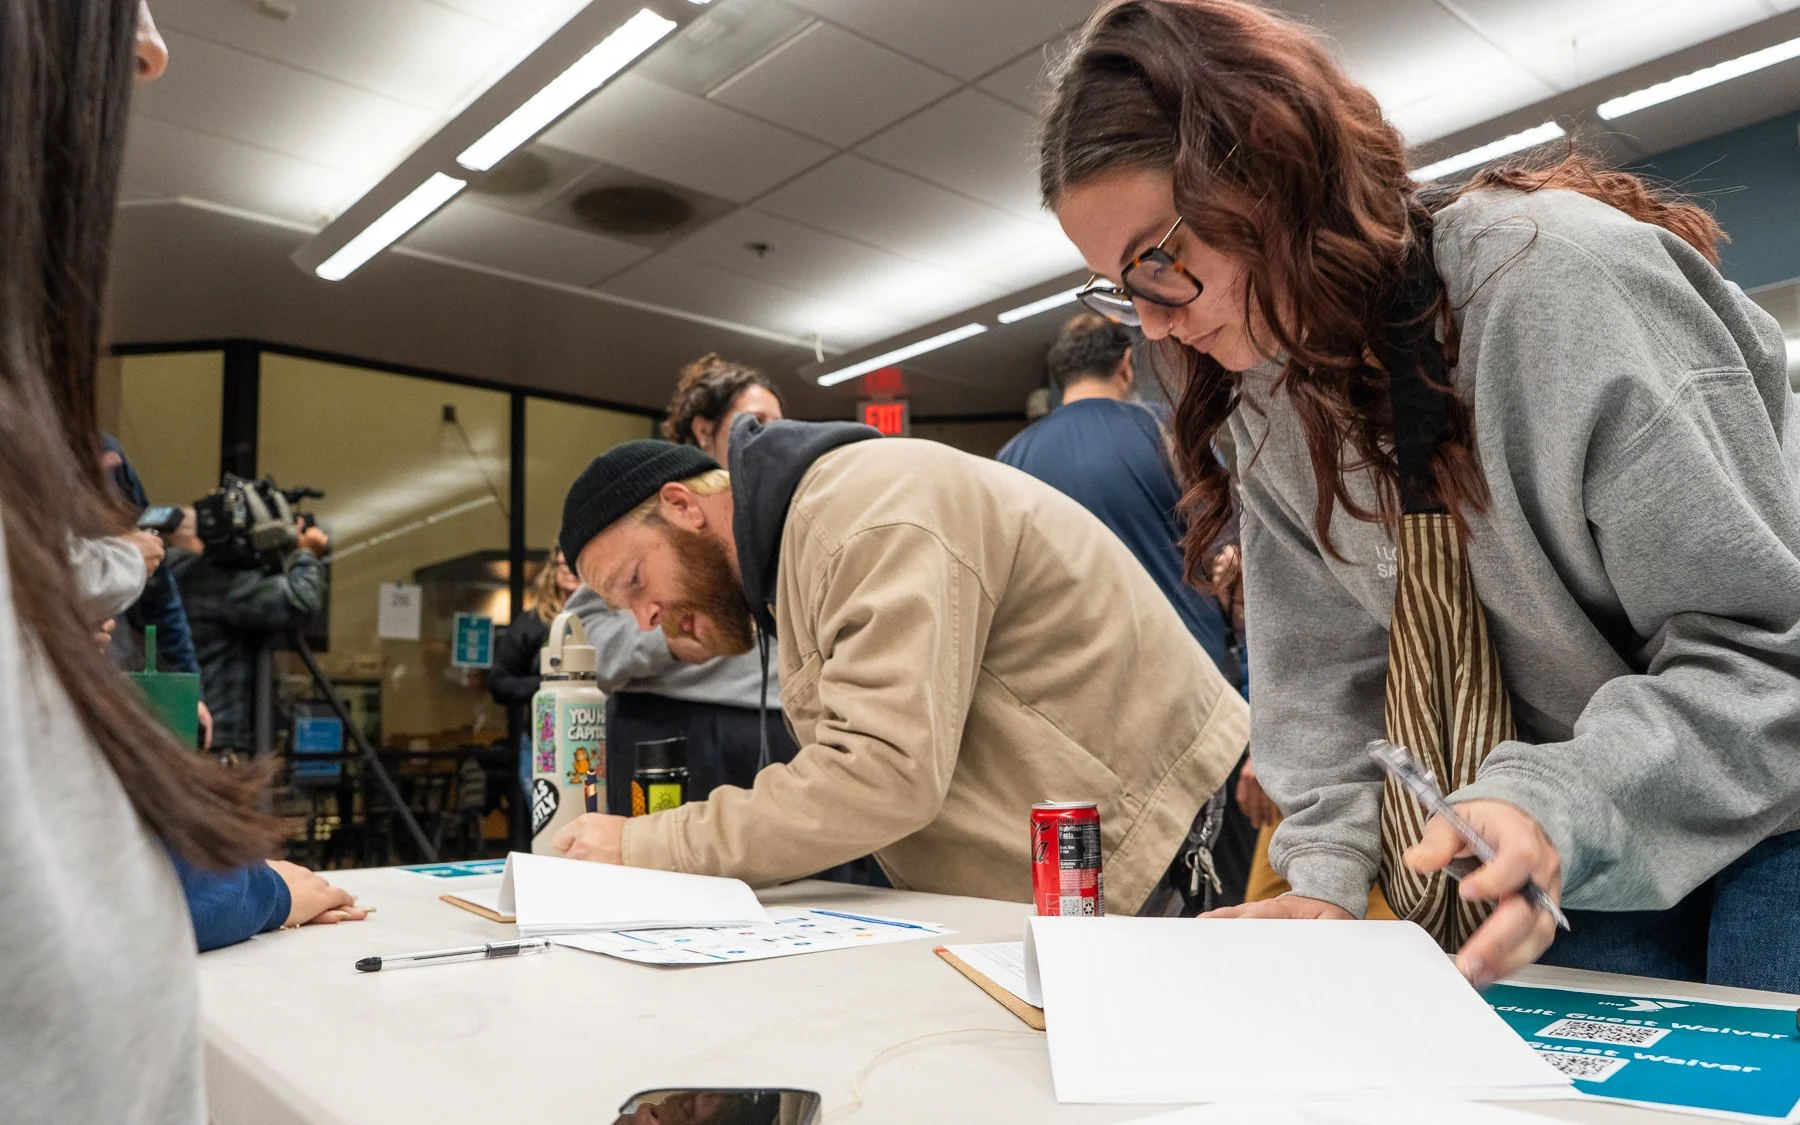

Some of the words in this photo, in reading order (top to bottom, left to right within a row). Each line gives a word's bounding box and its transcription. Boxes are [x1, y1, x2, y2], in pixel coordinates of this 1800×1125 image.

[865, 403, 904, 435] EXIT
[568, 708, 596, 725] YOU
[1565, 1012, 1659, 1027] Guest
[1671, 1022, 1789, 1039] Waiver
[1633, 1052, 1761, 1073] Waiver
